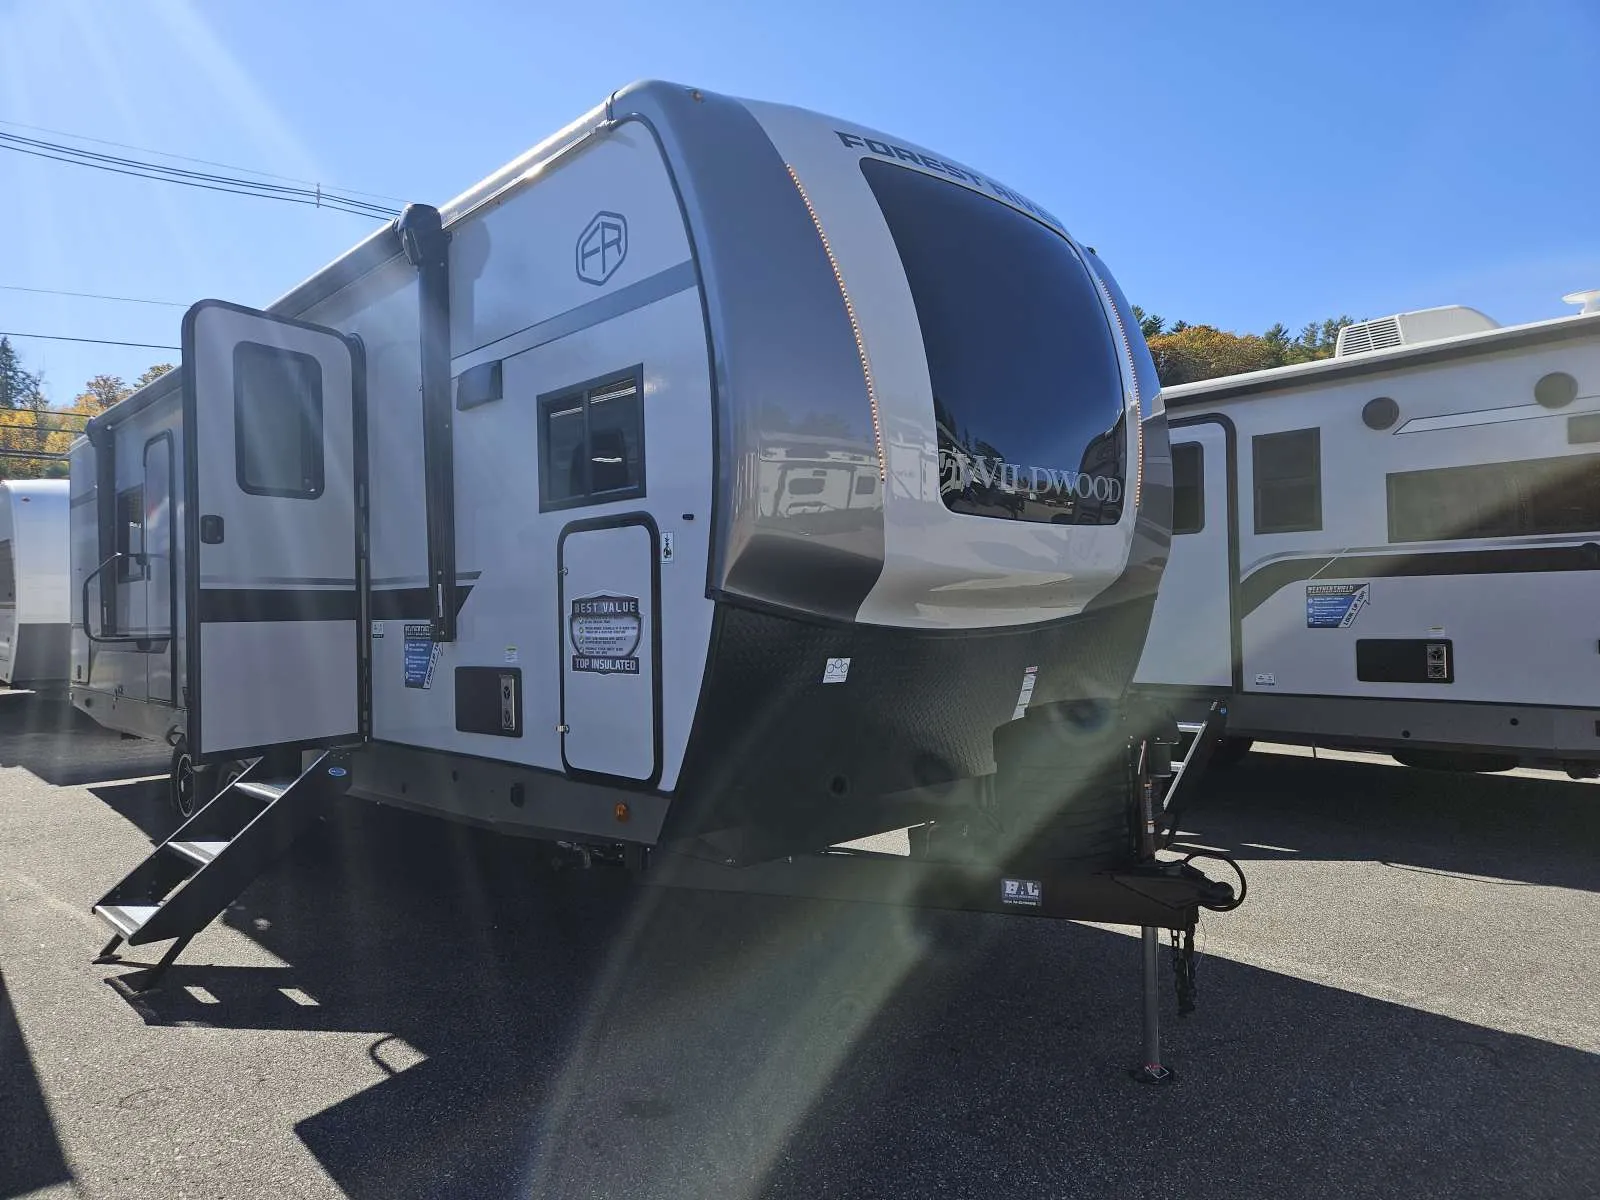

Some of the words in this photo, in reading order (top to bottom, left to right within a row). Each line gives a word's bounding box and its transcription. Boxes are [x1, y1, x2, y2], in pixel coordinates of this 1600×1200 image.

[833, 130, 983, 187] FOREST
[951, 448, 1122, 503] WILDWOOD
[574, 602, 598, 613] BEST
[602, 601, 636, 613] VALUE
[575, 658, 590, 669] TOP
[591, 658, 636, 671] INSULATED
